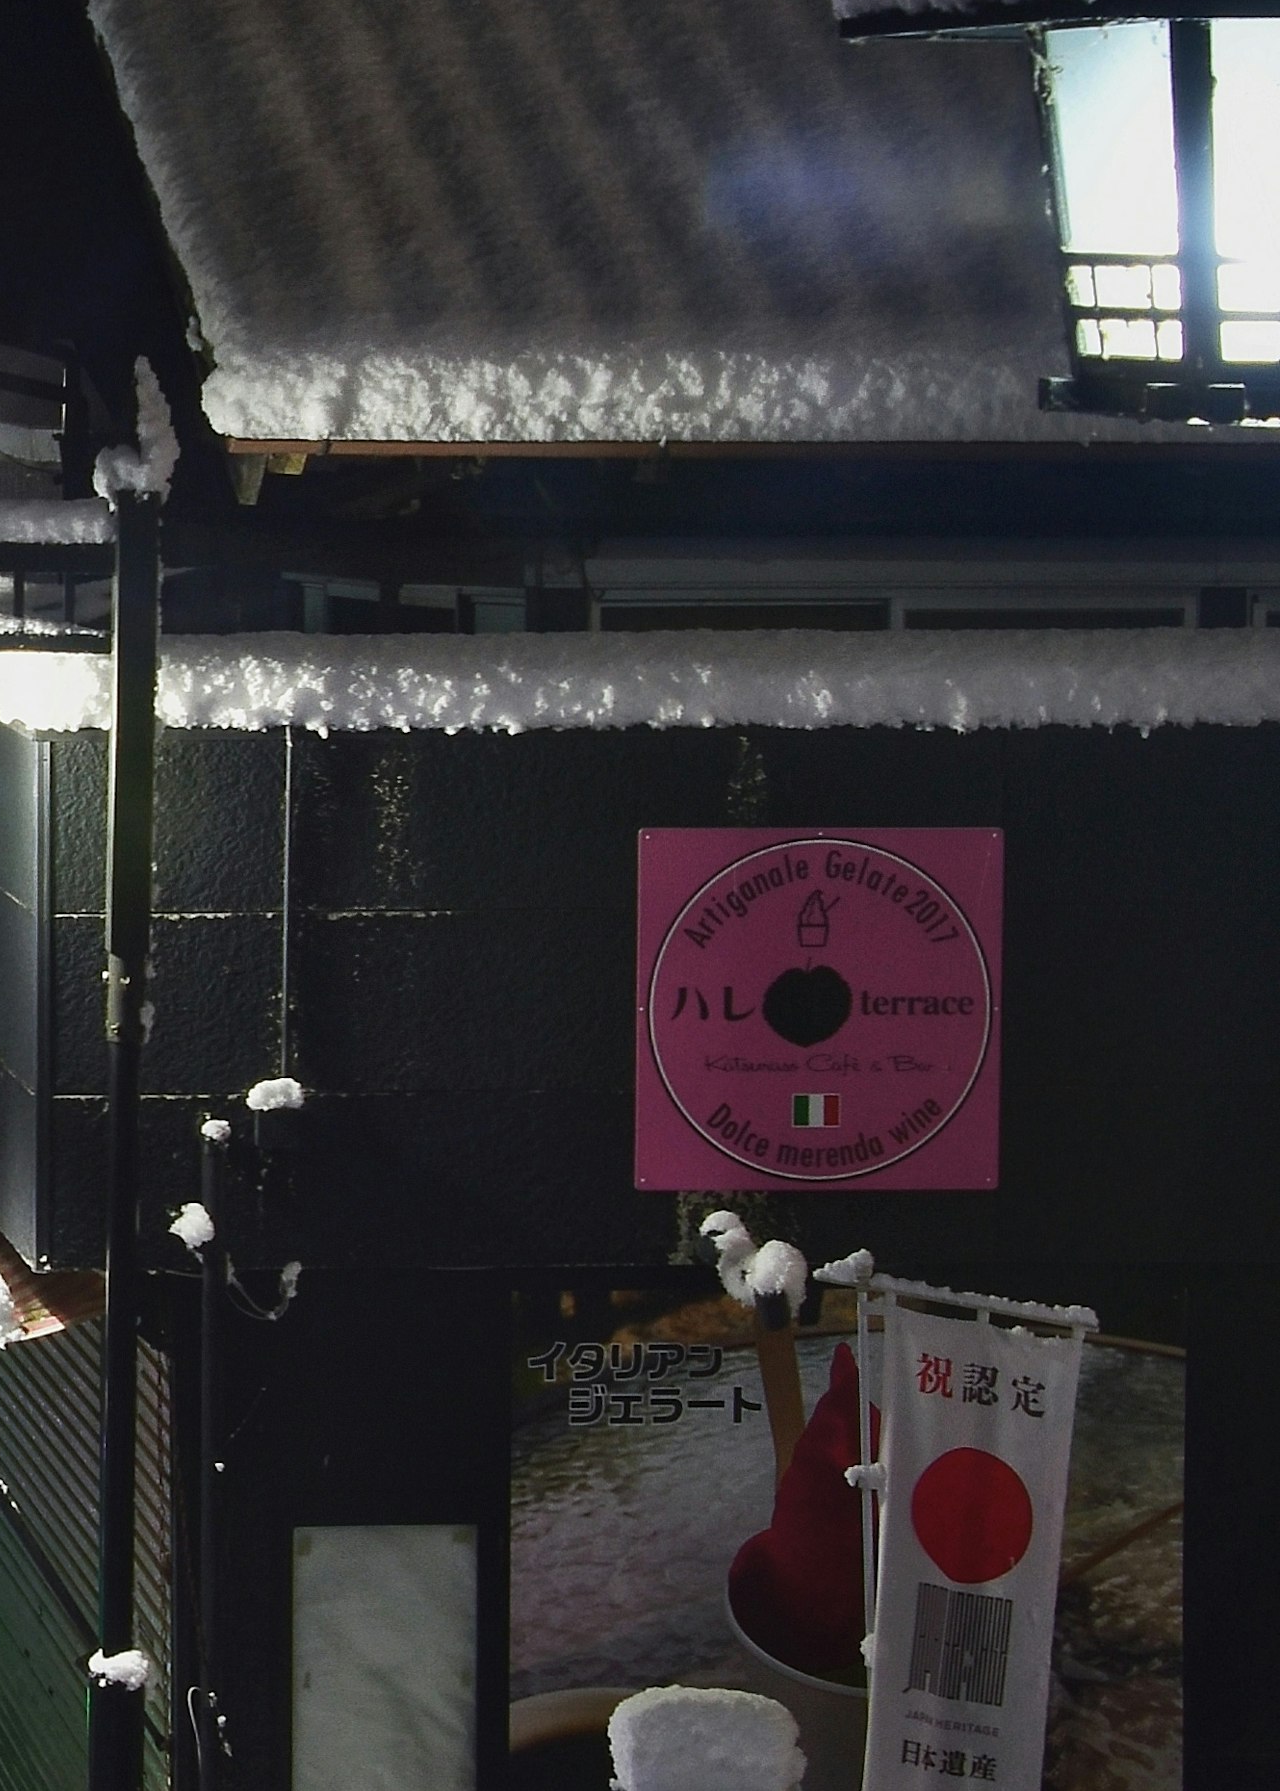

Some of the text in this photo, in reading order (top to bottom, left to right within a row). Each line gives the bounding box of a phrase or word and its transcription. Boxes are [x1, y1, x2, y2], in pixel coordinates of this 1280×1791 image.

[860, 990, 974, 1016] terrace
[706, 1098, 941, 1168] Dolce merenda wine
[528, 1341, 724, 1381] イタリアン
[569, 1384, 762, 1425] ジェラート
[901, 1739, 997, 1781] 日本遺産
